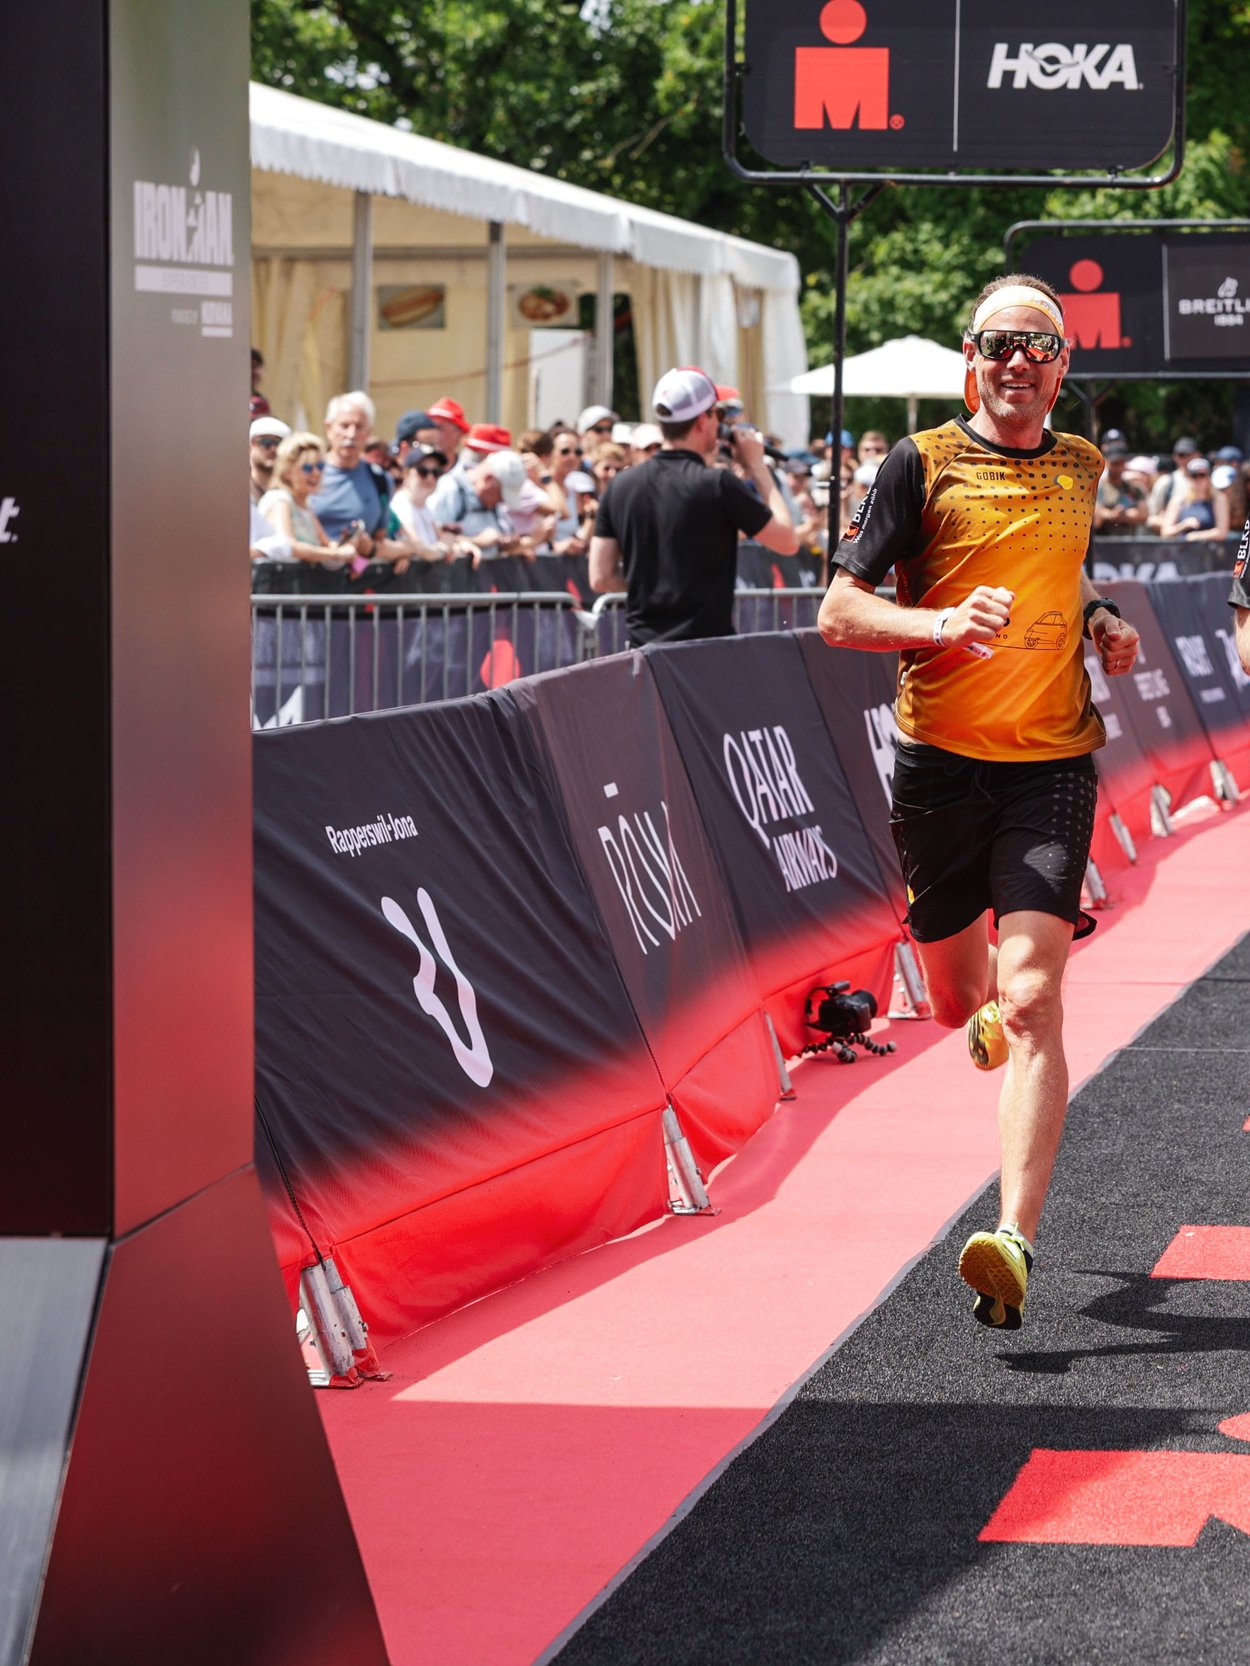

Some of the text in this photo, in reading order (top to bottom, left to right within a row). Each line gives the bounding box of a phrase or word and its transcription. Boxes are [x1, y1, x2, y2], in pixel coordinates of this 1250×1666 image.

[987, 42, 1138, 90] HOKA
[976, 471, 1006, 481] GOBIK
[723, 725, 815, 849] QATAR
[325, 812, 419, 858] Rapperswil-Jona
[773, 825, 838, 892] AIRWAYS
